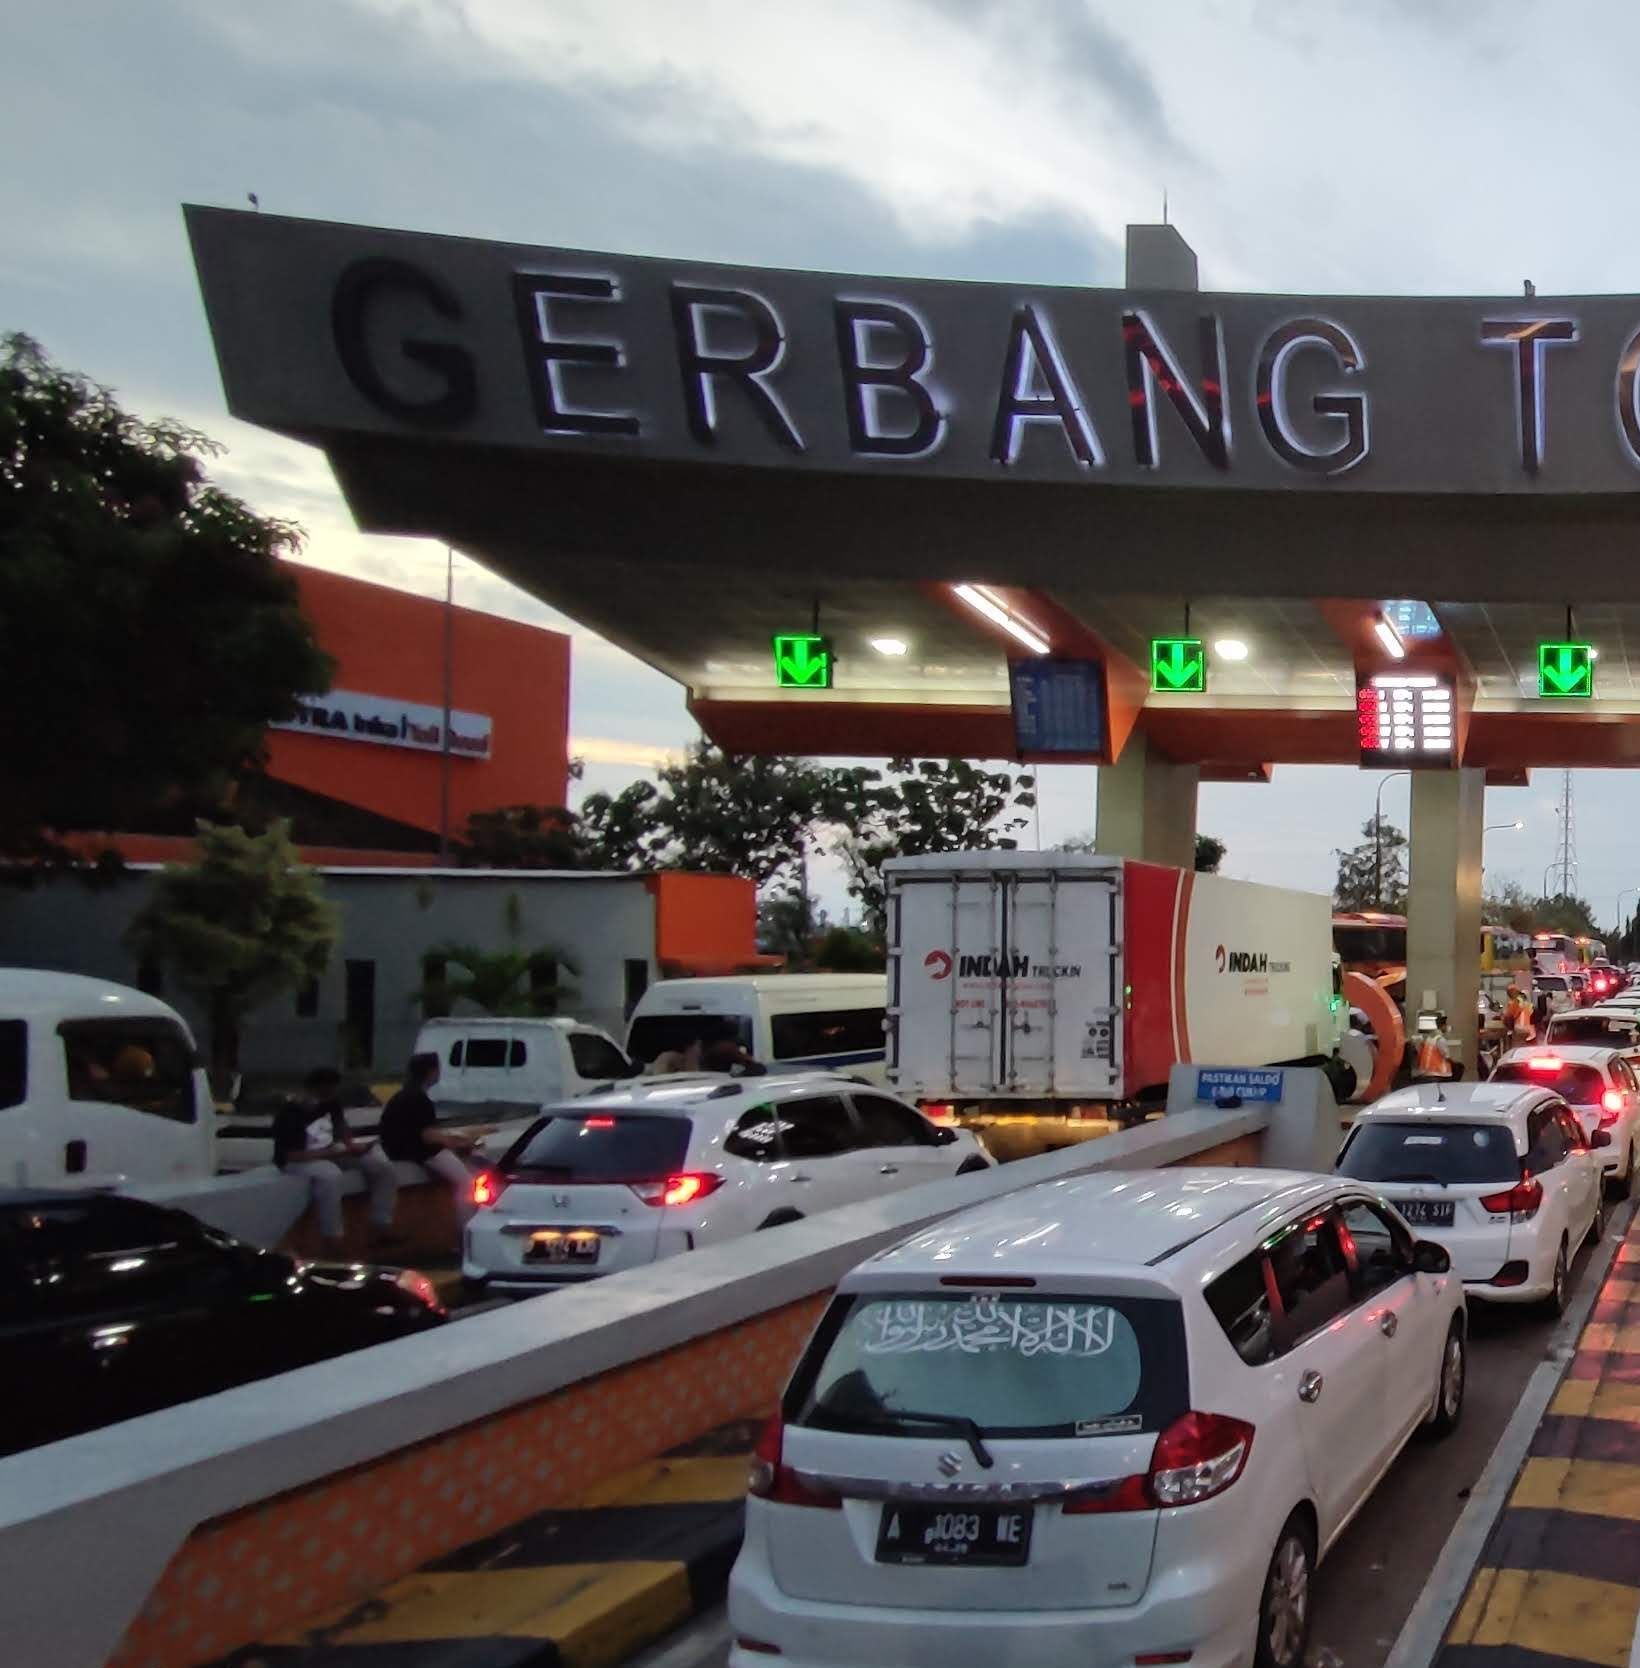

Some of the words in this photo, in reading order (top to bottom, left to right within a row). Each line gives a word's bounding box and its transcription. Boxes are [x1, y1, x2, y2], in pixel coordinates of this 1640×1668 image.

[330, 254, 1370, 476] GERBANG
[1228, 951, 1268, 973] INDAH
[1202, 1072, 1247, 1084] PASTIKAN
[1249, 1073, 1281, 1086] SALDO
[887, 1511, 901, 1540] A
